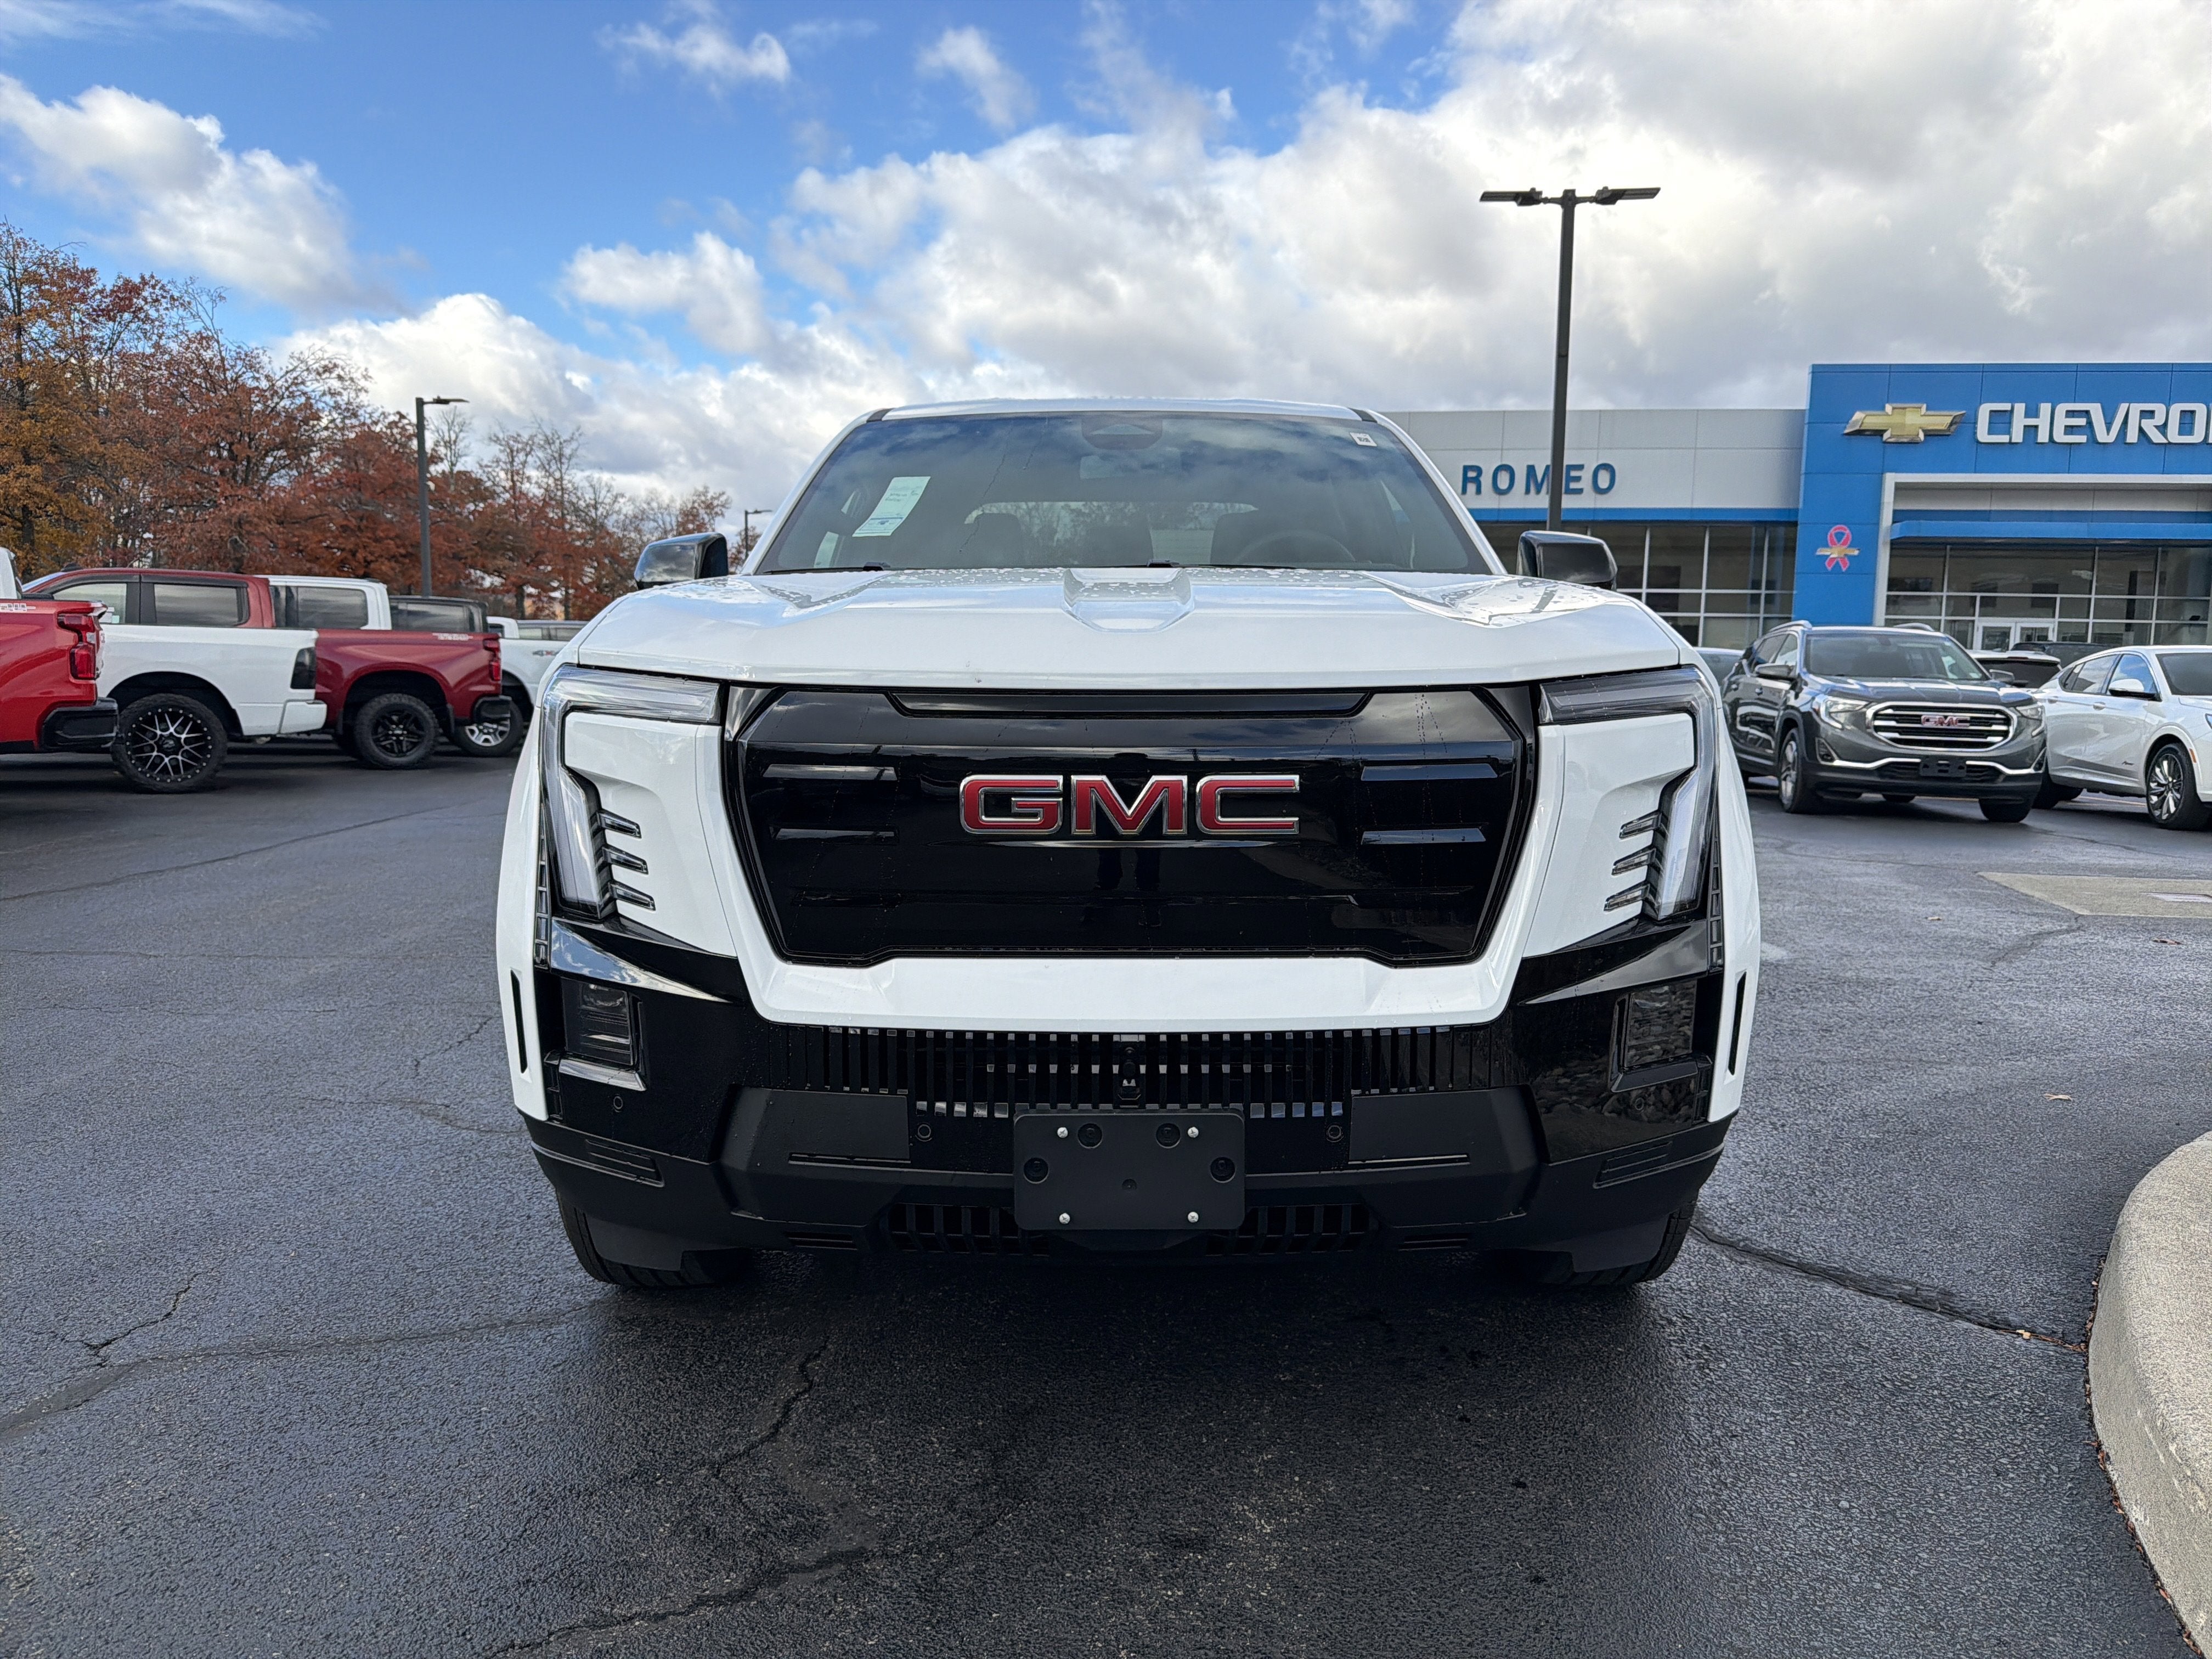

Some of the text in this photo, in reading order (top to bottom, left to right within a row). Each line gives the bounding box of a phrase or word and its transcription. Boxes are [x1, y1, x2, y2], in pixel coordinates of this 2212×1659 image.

[1977, 403, 2212, 443] CHEVRO
[1461, 463, 1616, 495] ROMEO
[1921, 715, 1971, 727] GMC
[959, 775, 1300, 834] GMC
